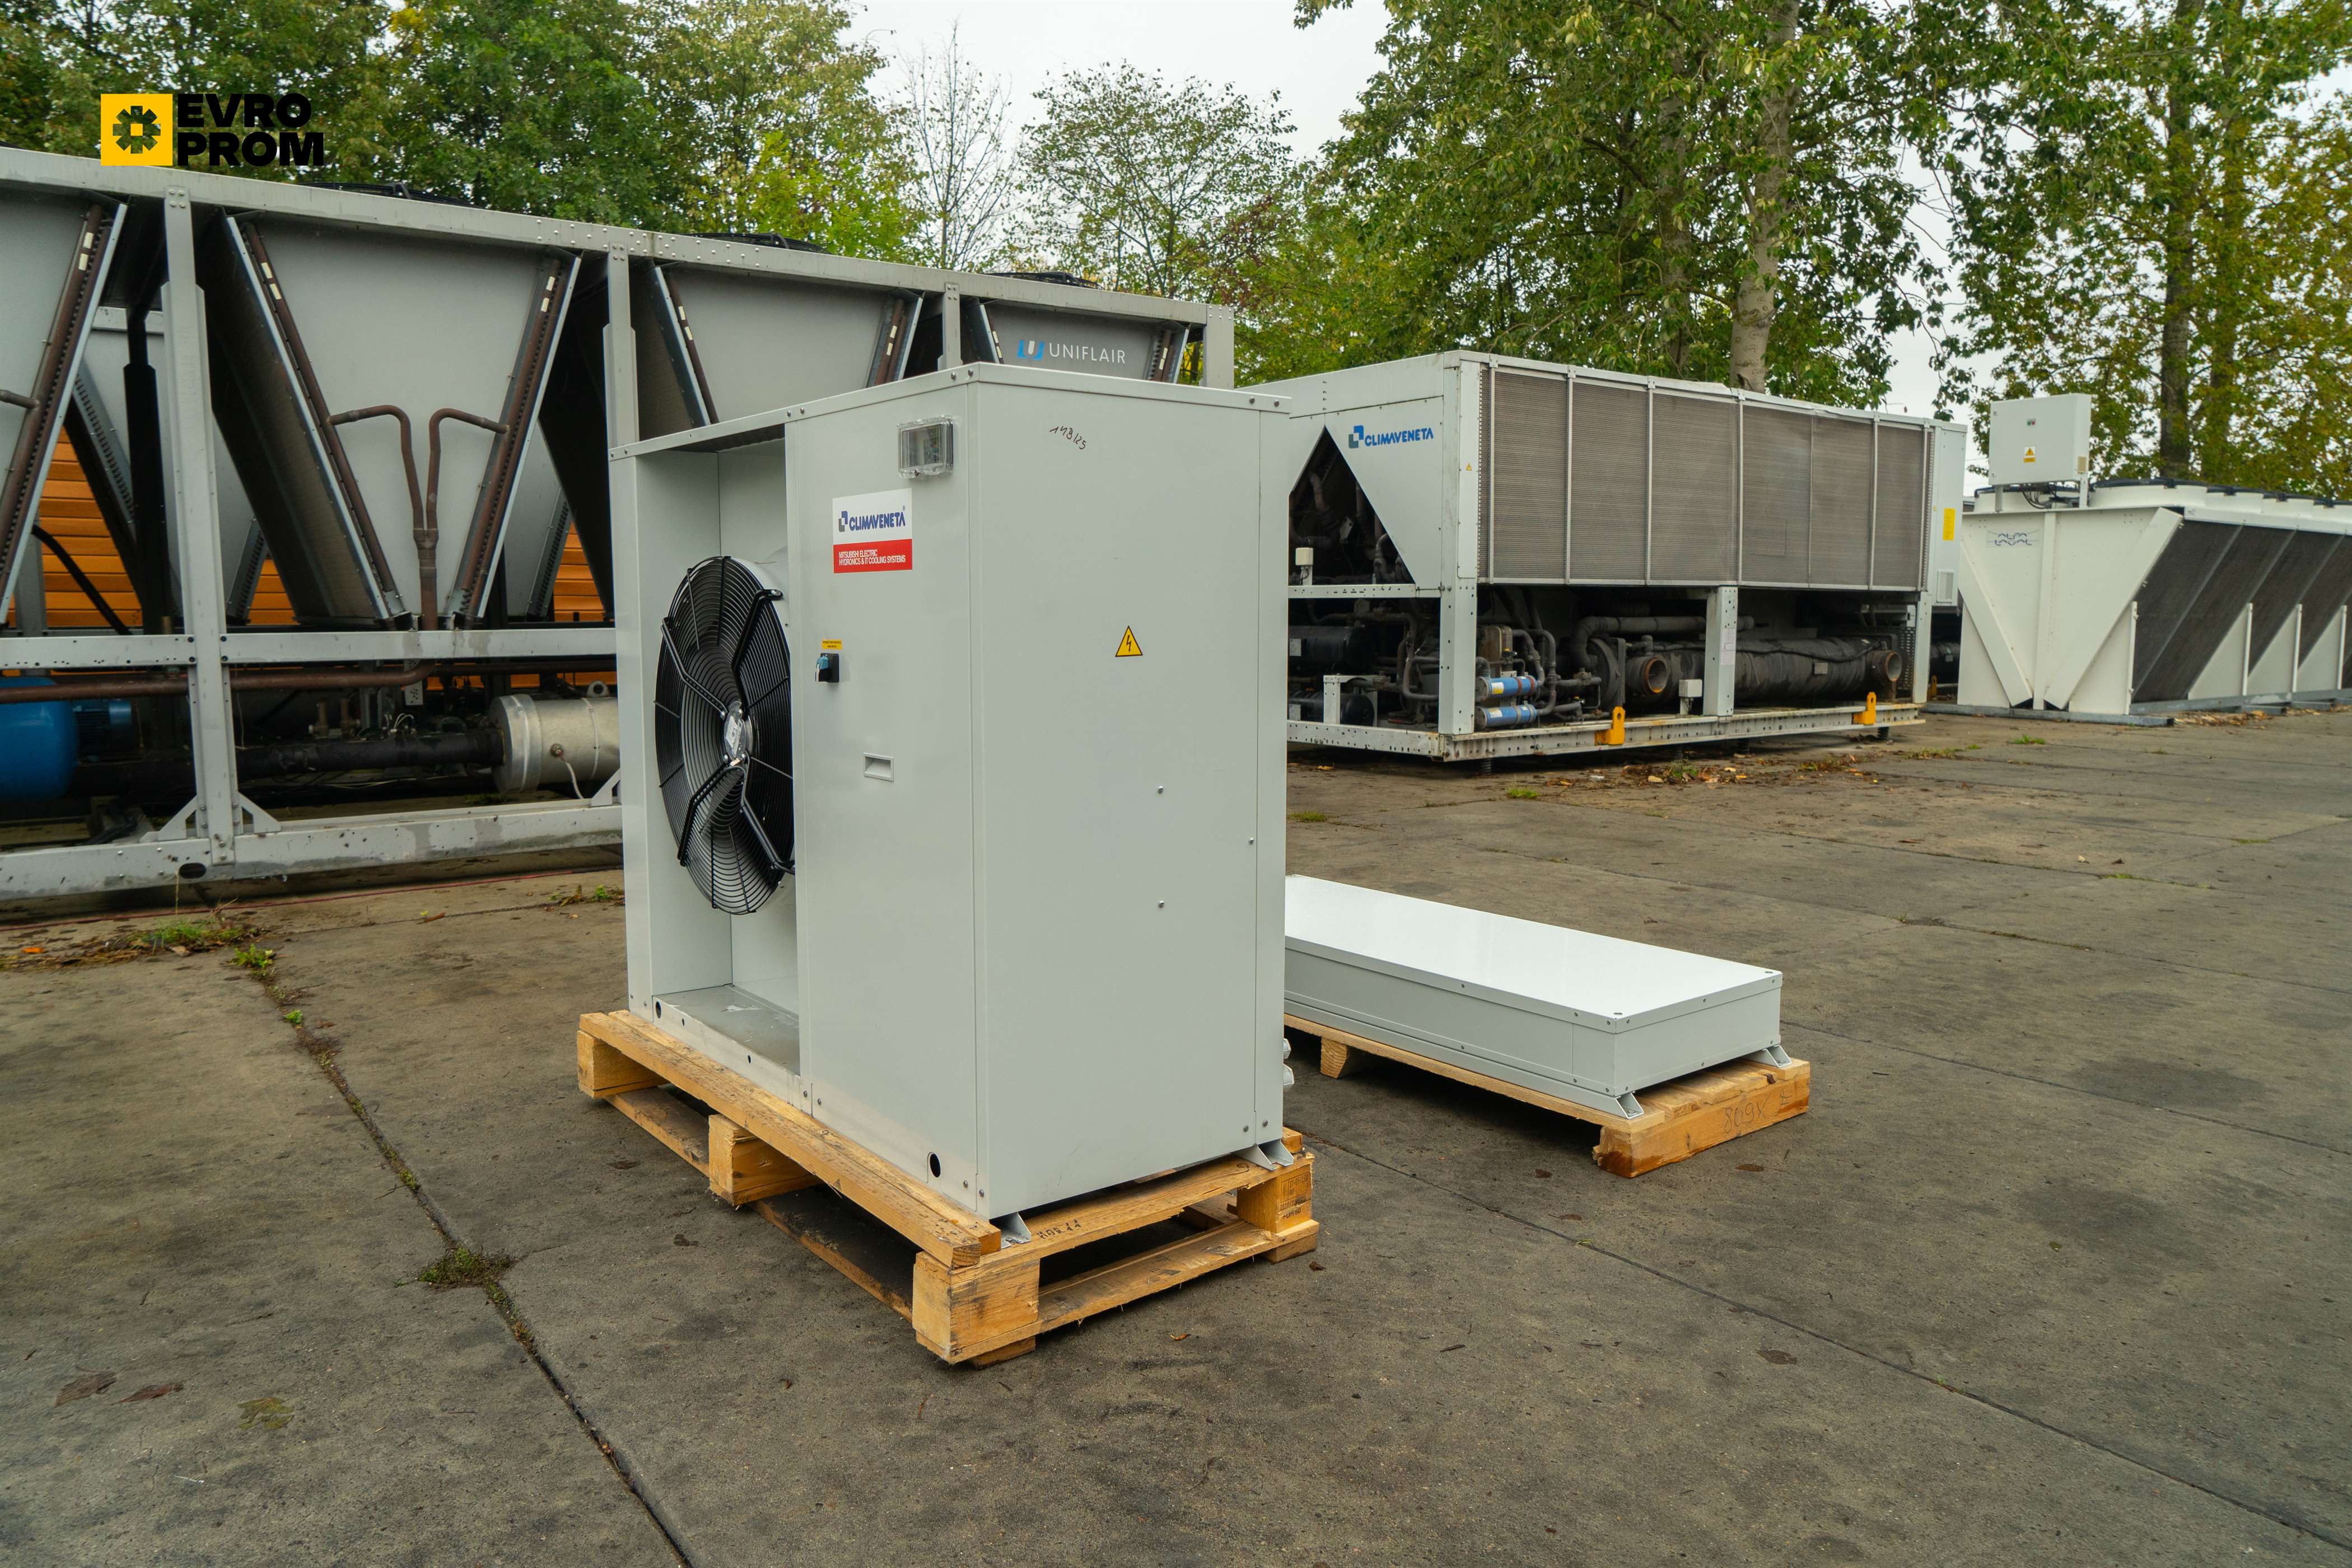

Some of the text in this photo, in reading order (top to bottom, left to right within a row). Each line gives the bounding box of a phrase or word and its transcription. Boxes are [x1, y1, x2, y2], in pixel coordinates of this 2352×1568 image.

[1049, 343, 1126, 364] UNIFLAIR
[1364, 427, 1434, 447] CLIMAVENETA
[849, 511, 906, 531] CLIMAVENETA
[838, 549, 878, 558] MITSUBISHI ELECTRIC
[839, 557, 861, 566] HYDRONICS
[869, 556, 886, 564] COOLING
[887, 554, 906, 563] SYSTEMS
